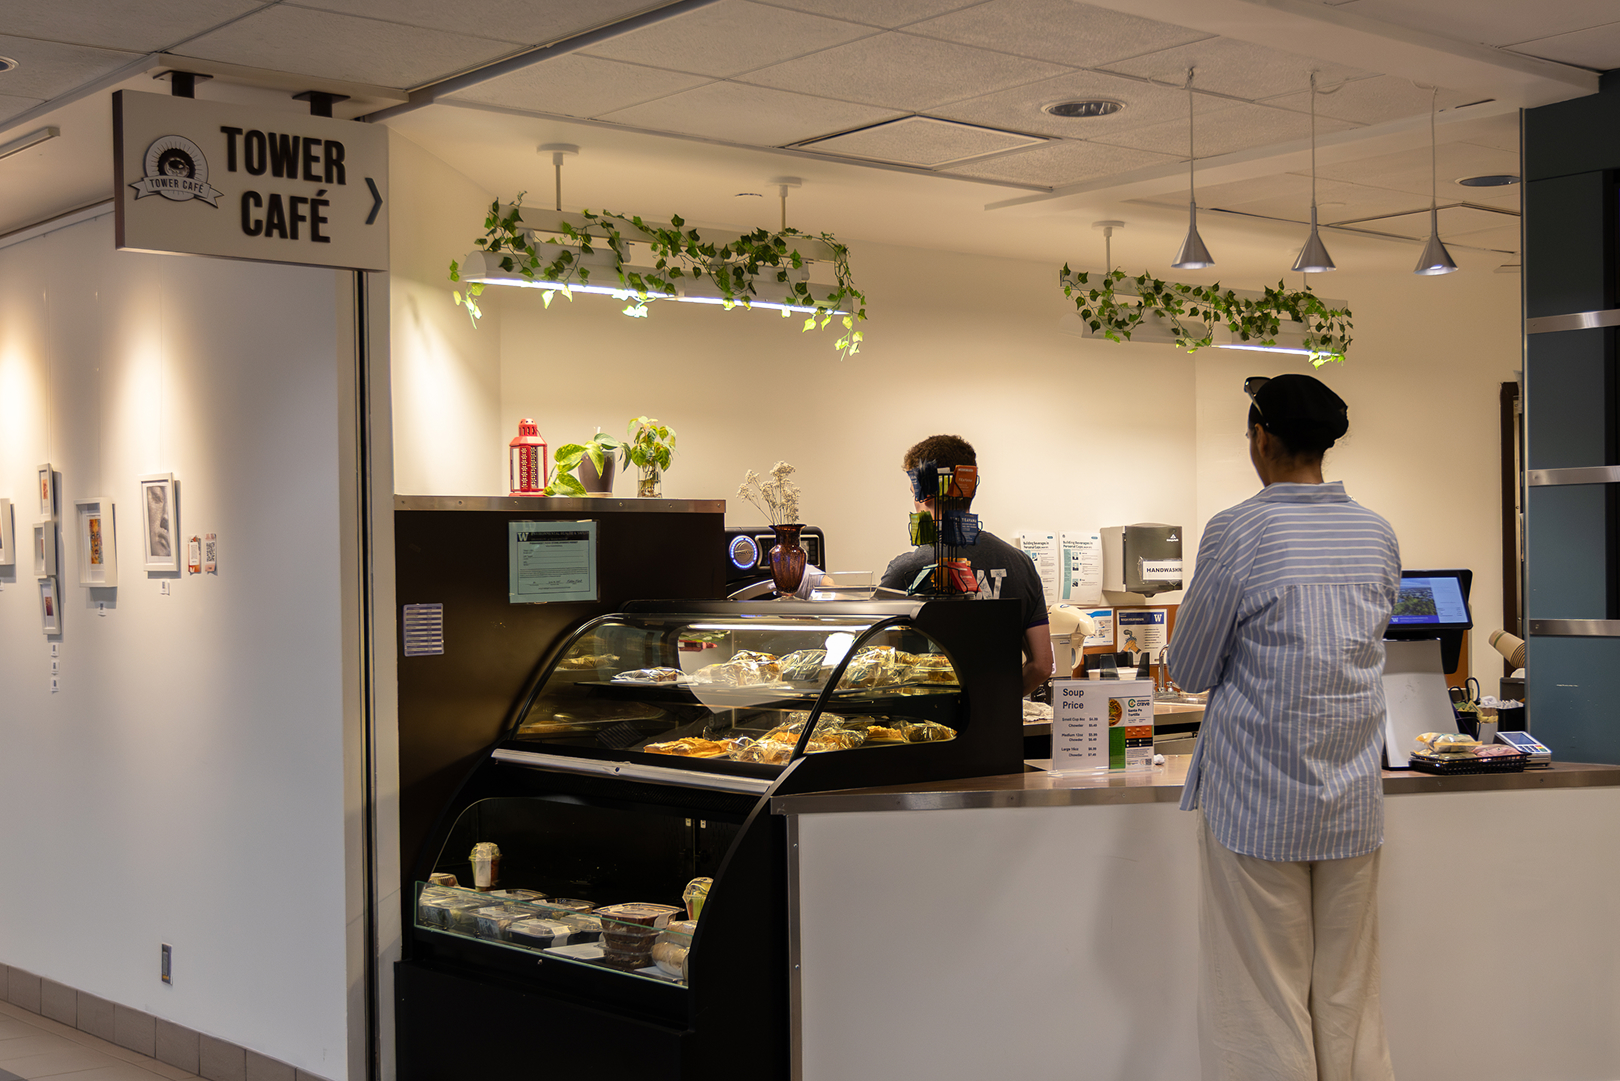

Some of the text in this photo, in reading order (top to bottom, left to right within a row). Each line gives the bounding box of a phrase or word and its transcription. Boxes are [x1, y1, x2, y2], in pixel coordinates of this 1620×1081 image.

[220, 126, 346, 185] TOWER
[150, 178, 204, 194] TOWER CAFÉ
[241, 189, 331, 243] CAFÉ
[517, 532, 529, 541] W
[1154, 614, 1162, 622] W
[1062, 688, 1084, 698] Soup
[1062, 701, 1084, 709] Price
